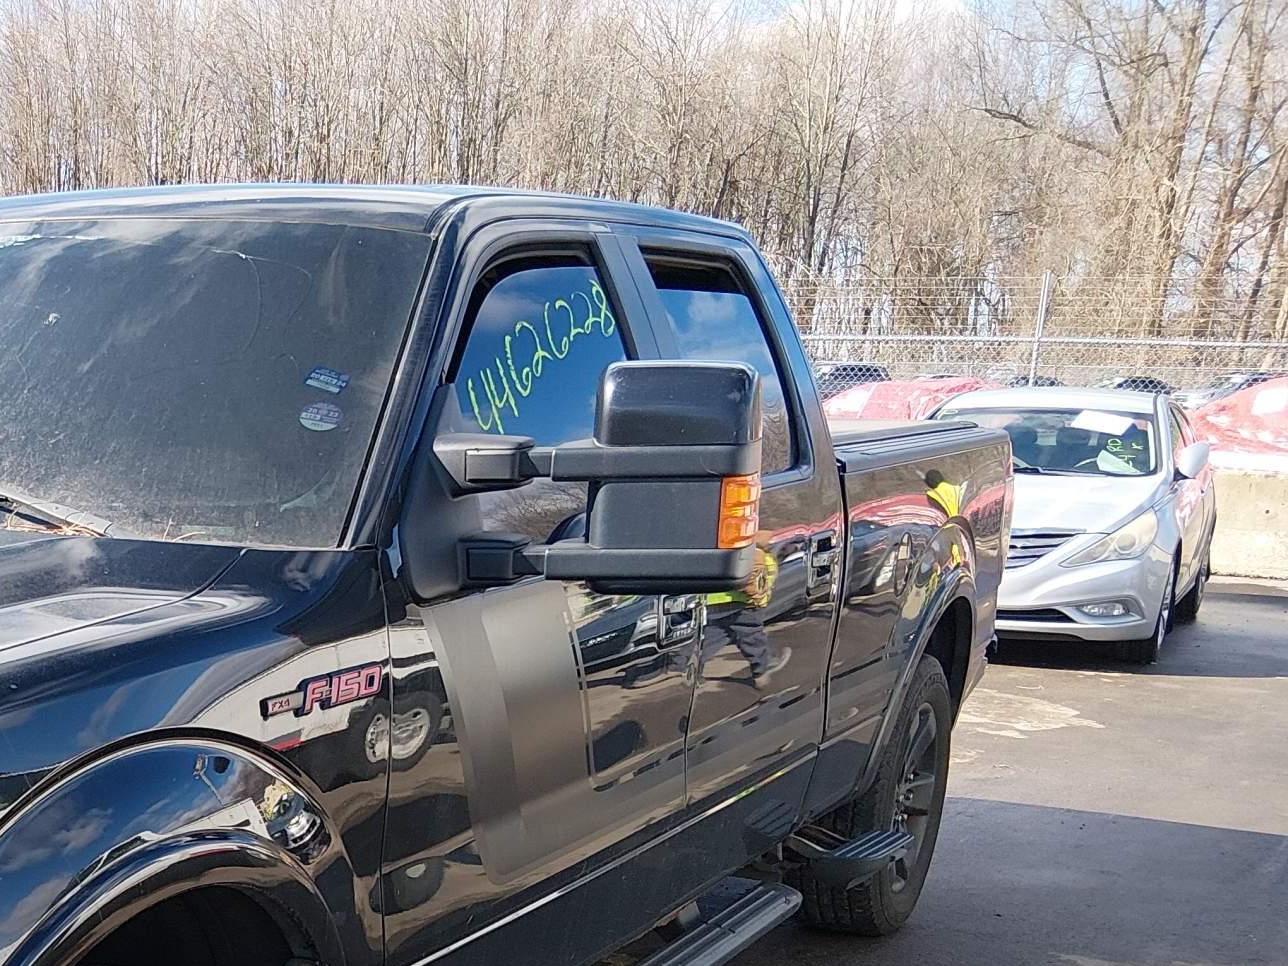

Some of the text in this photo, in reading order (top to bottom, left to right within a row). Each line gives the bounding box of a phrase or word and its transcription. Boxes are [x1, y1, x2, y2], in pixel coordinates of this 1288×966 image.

[468, 279, 616, 435] 44626228
[270, 697, 291, 712] FX4
[303, 665, 383, 714] F-150
